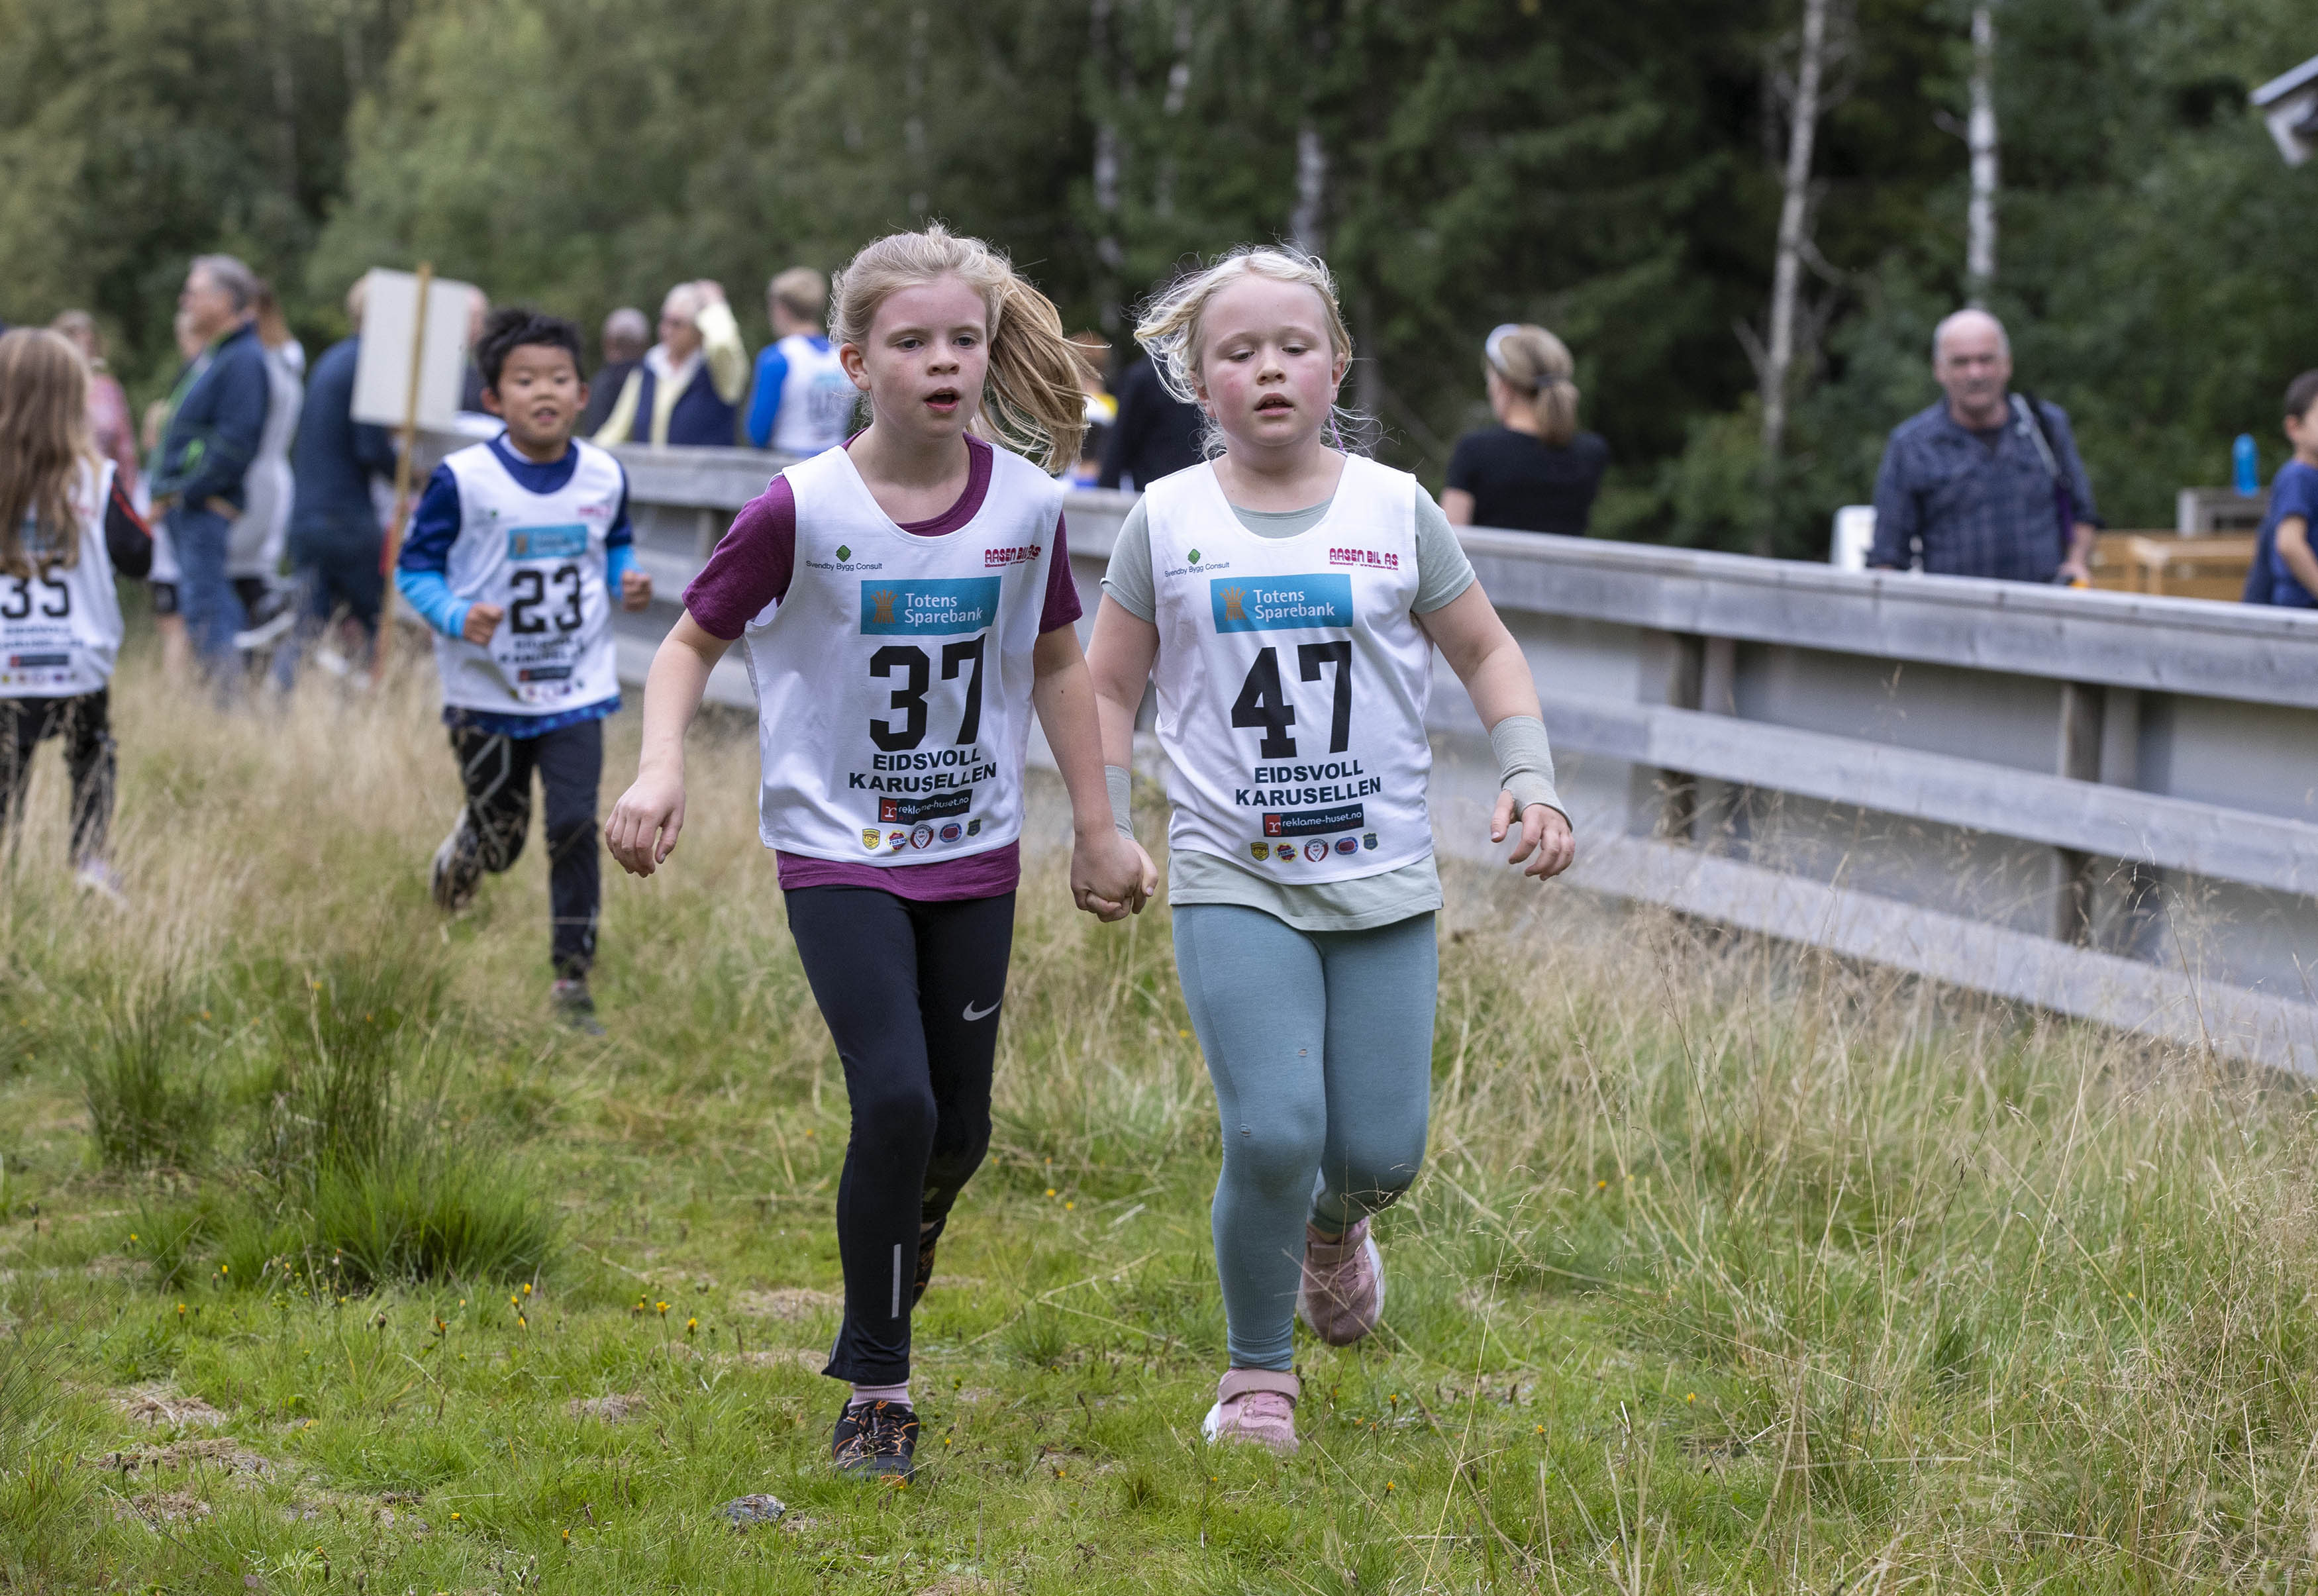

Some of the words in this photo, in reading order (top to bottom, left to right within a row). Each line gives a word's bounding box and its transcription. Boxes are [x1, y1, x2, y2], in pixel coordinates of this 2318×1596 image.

[985, 547, 1017, 563] AASEN
[1329, 548, 1364, 562] AASEN
[1367, 550, 1382, 564] BIL
[1384, 552, 1399, 566] AS
[805, 560, 834, 571] Svendby
[836, 563, 854, 572] Bygg
[1164, 568, 1187, 577] Svendby
[1205, 562, 1230, 570] Consult
[511, 564, 583, 633] 23
[905, 593, 958, 608] Totens
[1253, 589, 1305, 604] Totens
[905, 607, 983, 627] Sparebank
[1254, 602, 1336, 623] Sparebank
[870, 633, 985, 752] 37
[1231, 640, 1352, 759] 47
[873, 748, 982, 772] EIDSVOLL
[849, 762, 997, 793] KARUSELLEN
[1254, 760, 1364, 783] EIDSVOLL
[1236, 777, 1381, 807] KARUSELLEN
[1282, 811, 1362, 827] reklame-huset.no
